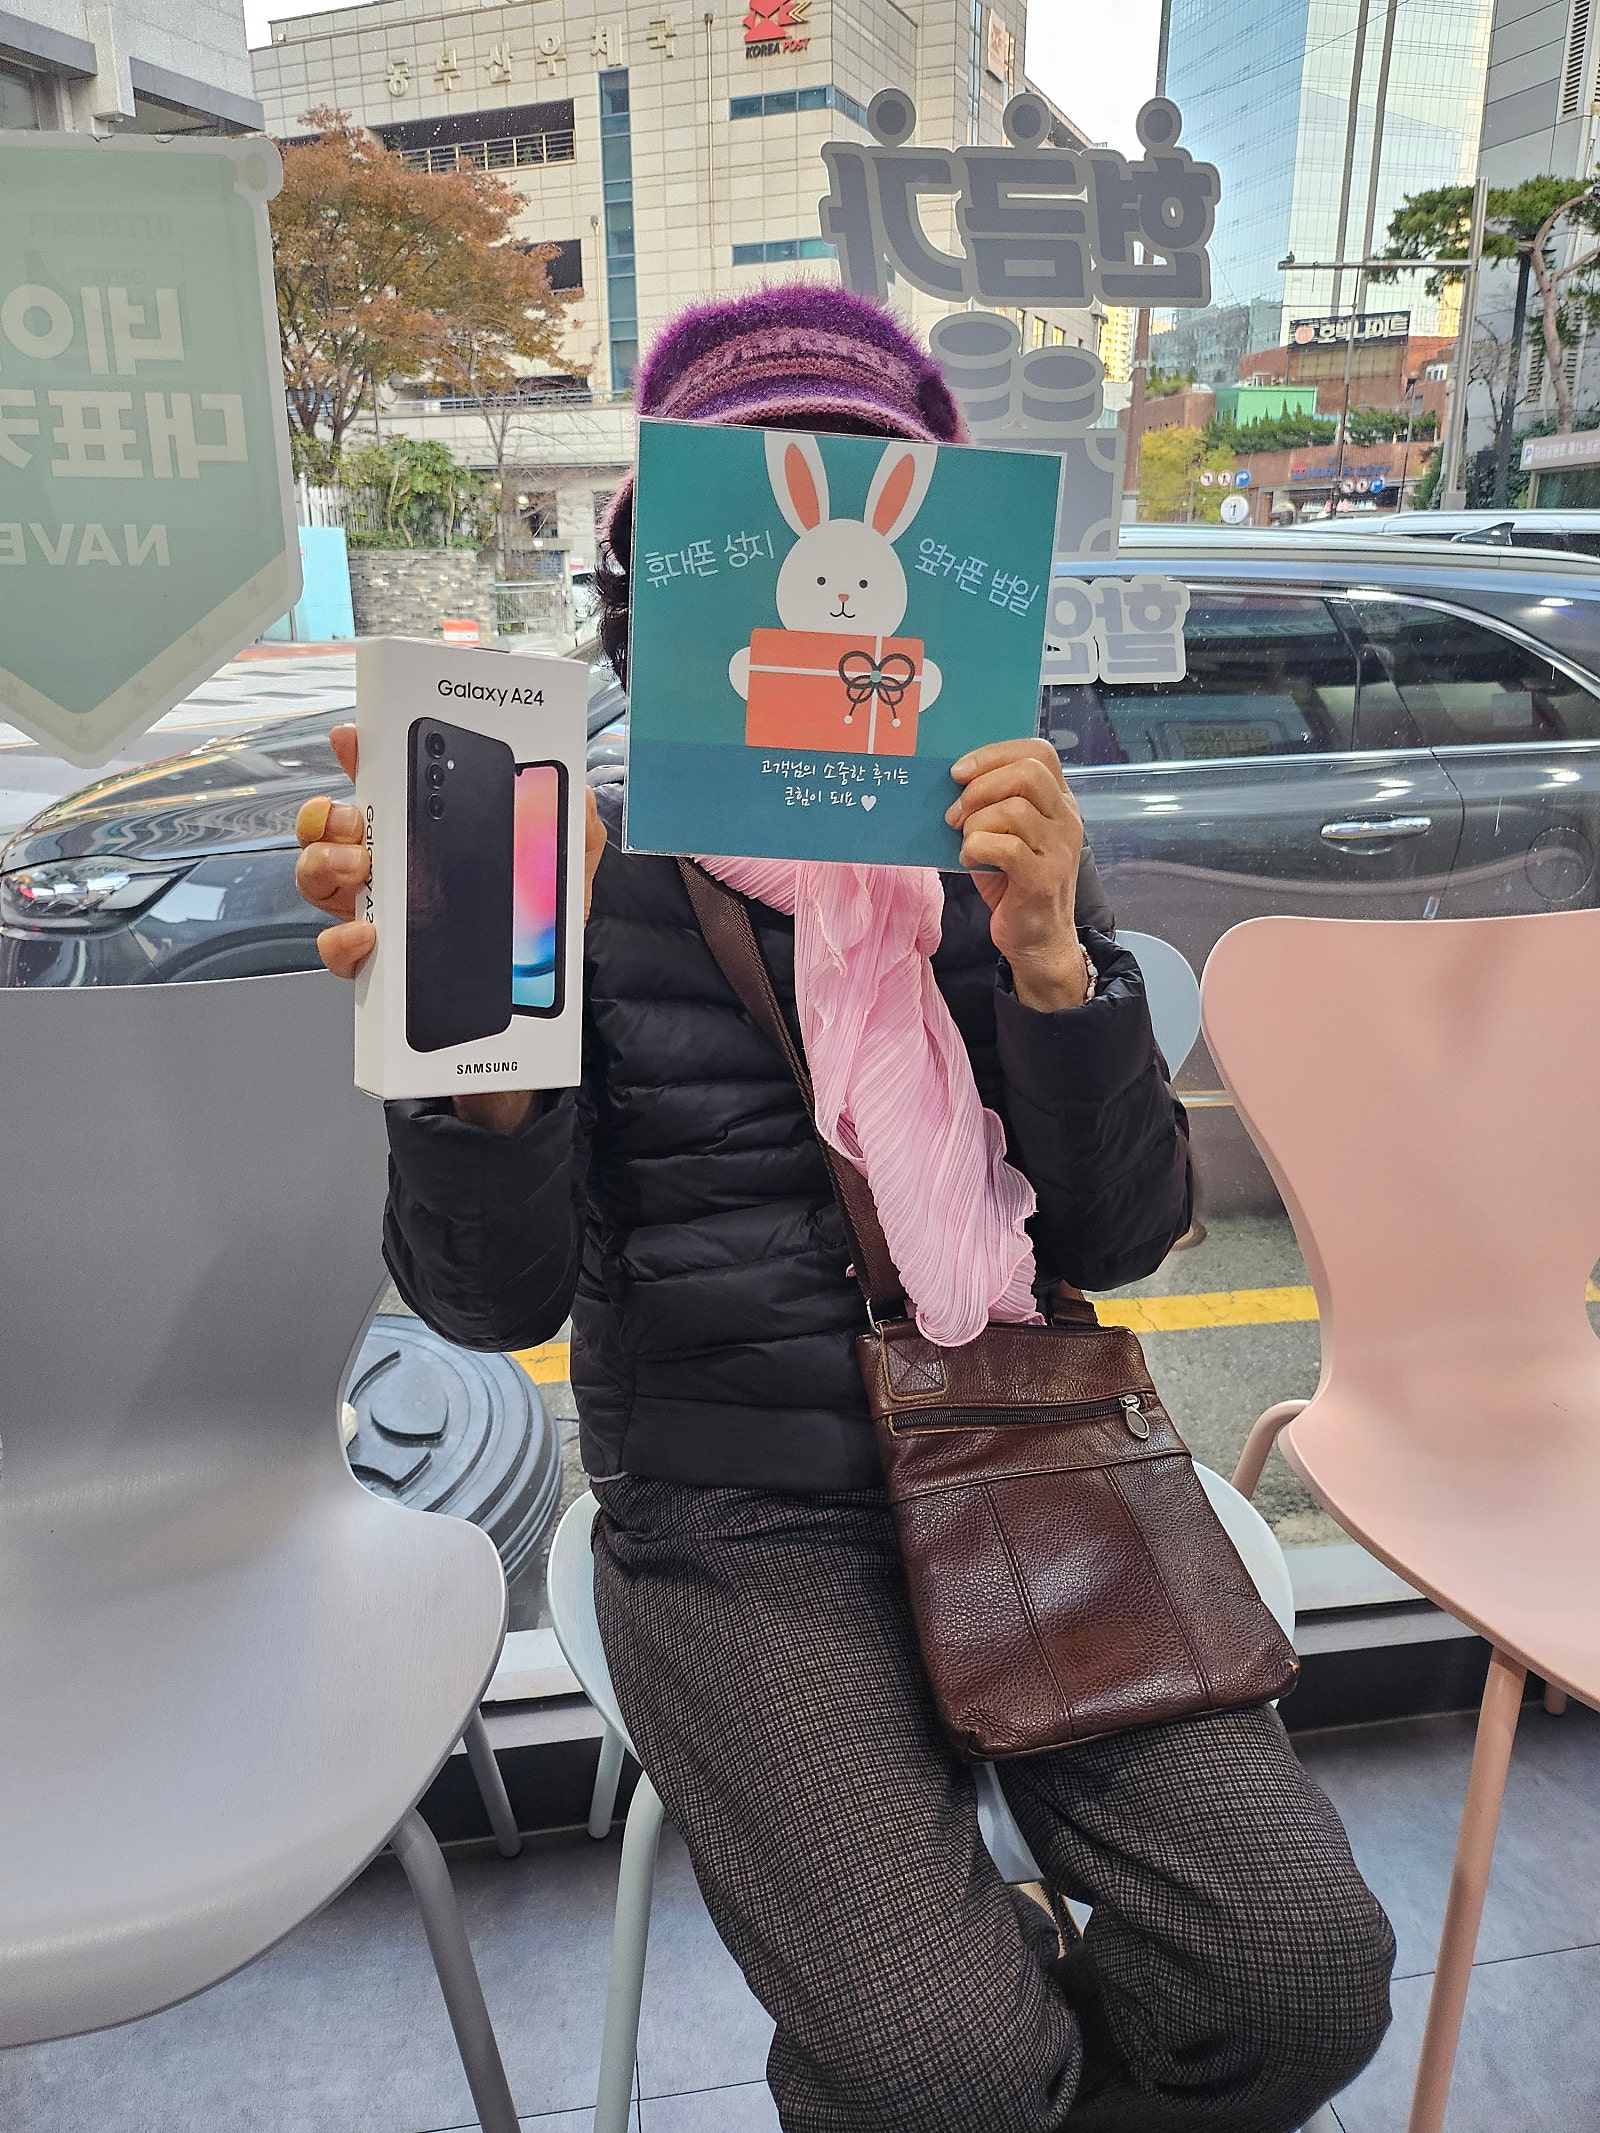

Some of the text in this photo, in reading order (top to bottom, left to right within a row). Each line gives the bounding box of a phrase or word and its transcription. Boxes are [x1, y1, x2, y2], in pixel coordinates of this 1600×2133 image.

[745, 37, 811, 59] KOREA POST
[644, 530, 774, 588] 휴대폰 성지
[914, 538, 1040, 617] 옆커폰 범일
[437, 679, 545, 707] Galaxy A24
[760, 759, 910, 787] 고객님의 소중한 후기는
[784, 786, 857, 807] 큰힘이 되요
[456, 1061, 518, 1075] SAMSUNG
